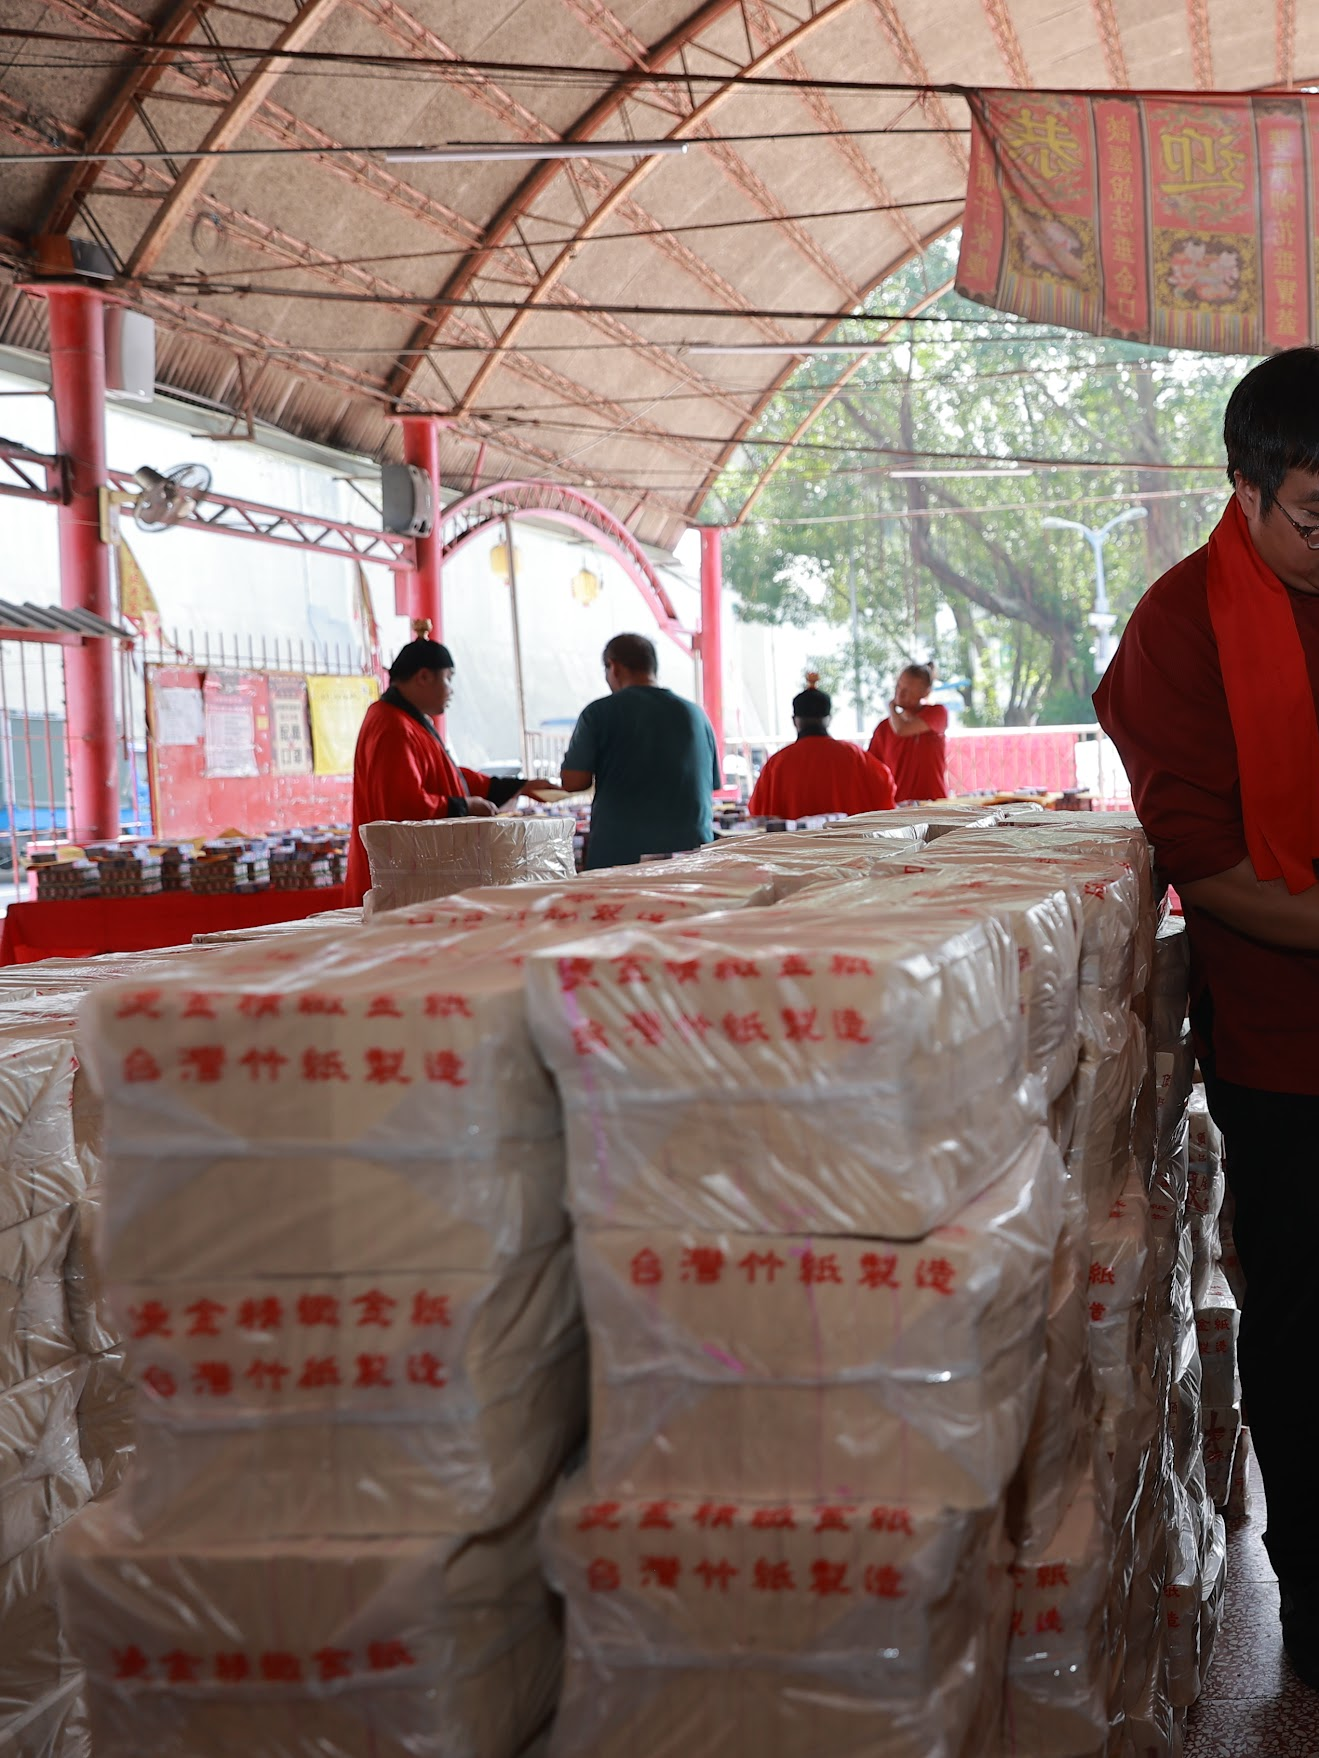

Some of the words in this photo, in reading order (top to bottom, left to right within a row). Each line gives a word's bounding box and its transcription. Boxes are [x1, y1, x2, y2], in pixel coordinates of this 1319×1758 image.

[122, 1044, 469, 1089] 台灣竹紙製造
[630, 1246, 957, 1296] 台灣竹紙製造
[587, 1555, 905, 1599] 台灣竹紙製造
